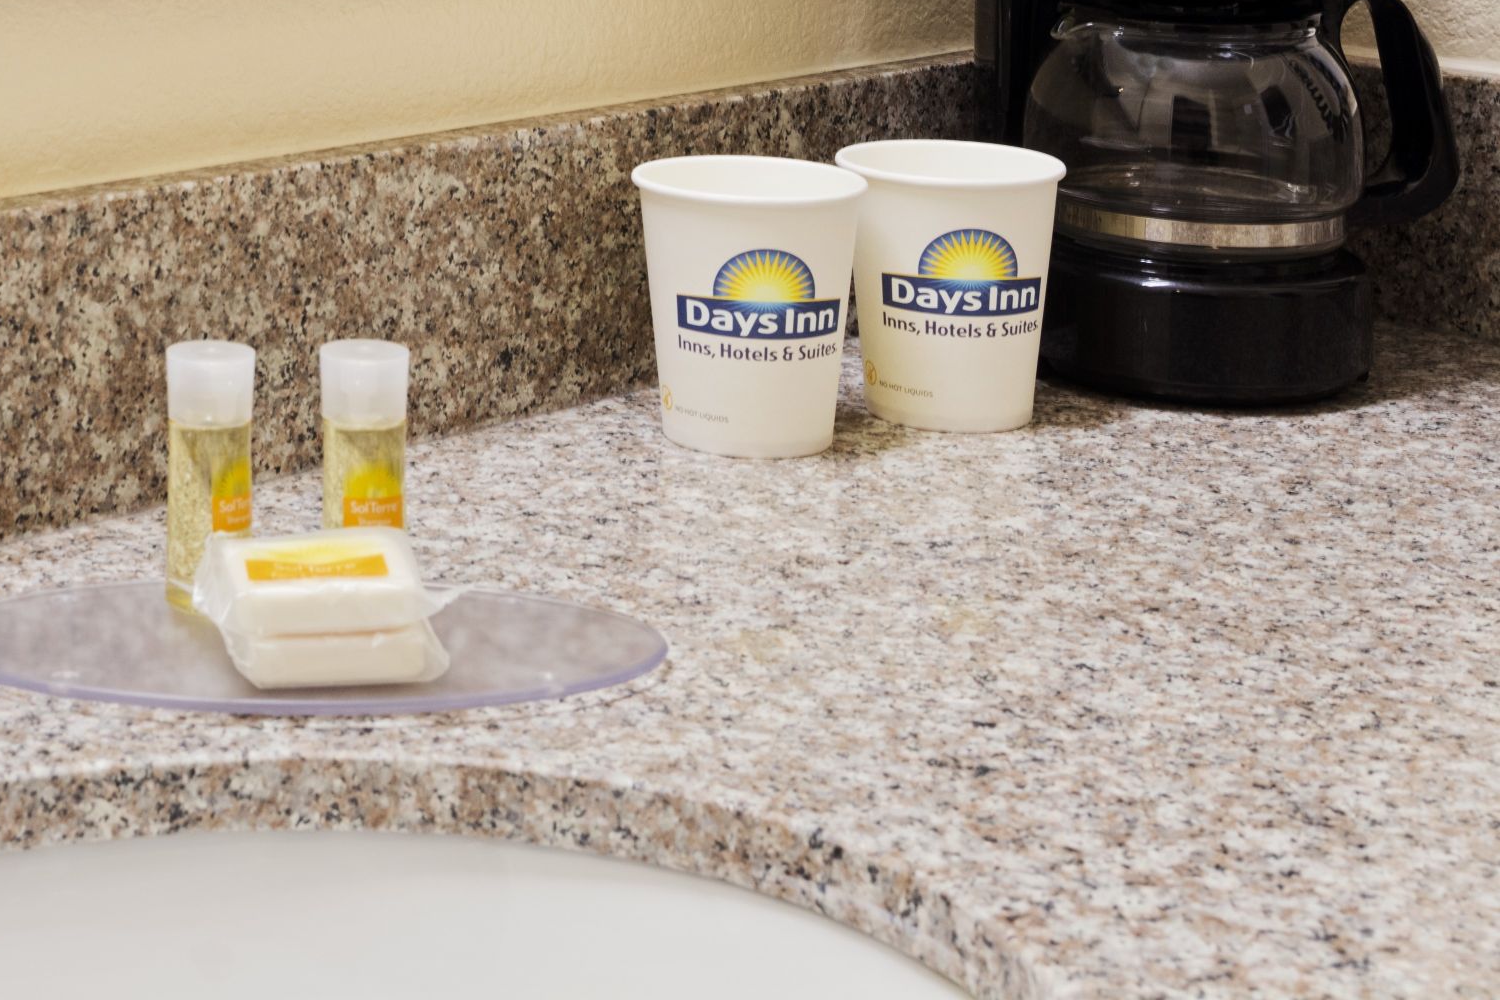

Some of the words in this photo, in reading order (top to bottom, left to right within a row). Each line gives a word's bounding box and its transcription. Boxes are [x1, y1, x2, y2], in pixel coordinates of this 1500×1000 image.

[891, 278, 982, 314] Days
[989, 286, 1035, 311] Inn
[686, 299, 778, 336] Days
[785, 308, 834, 334] Inn
[883, 311, 920, 335] Inns,
[925, 320, 981, 338] Hotels
[986, 323, 996, 337] &
[1002, 320, 1037, 337] Suites
[678, 334, 715, 359] Inns,
[720, 343, 777, 361] Hotels
[783, 346, 792, 361] &
[798, 342, 836, 360] Suites
[889, 384, 901, 392] HOT
[904, 388, 933, 397] LIQUIDS
[700, 412, 729, 423] LIQUIDS
